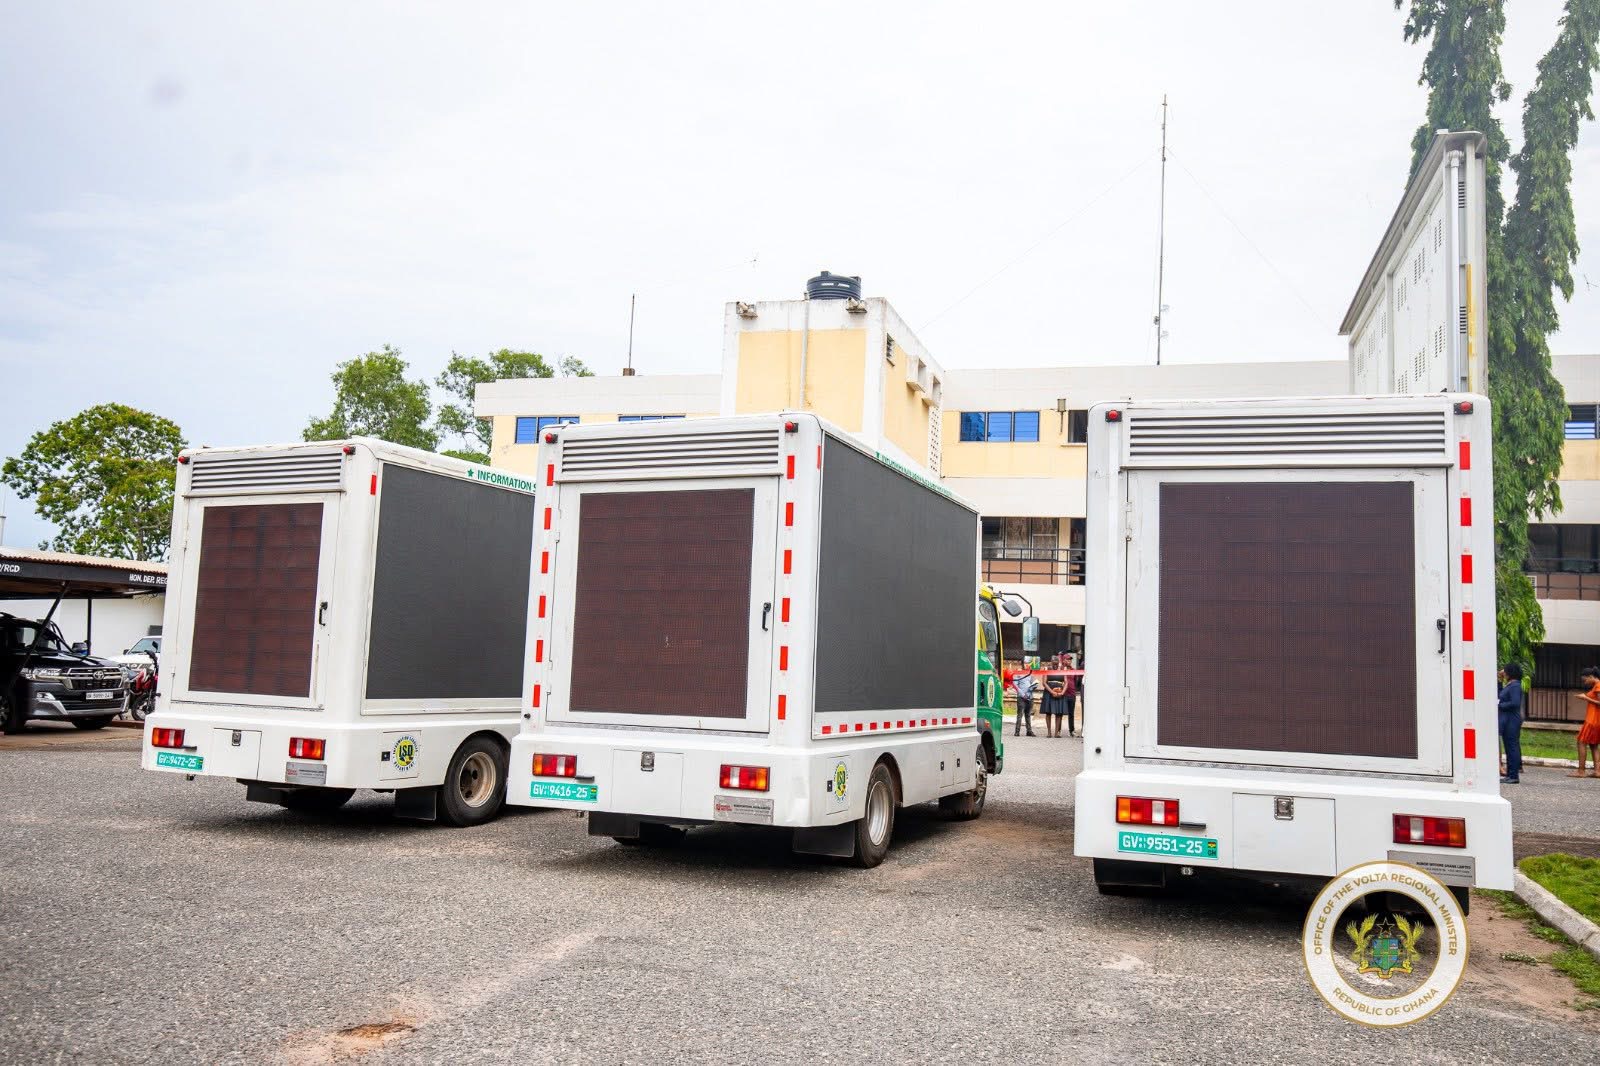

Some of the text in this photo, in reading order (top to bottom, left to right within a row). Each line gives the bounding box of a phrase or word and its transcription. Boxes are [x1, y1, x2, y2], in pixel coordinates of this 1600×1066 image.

[477, 469, 532, 491] INFORMATION
[549, 785, 589, 799] 9416-25
[1146, 837, 1203, 854] 9551-25
